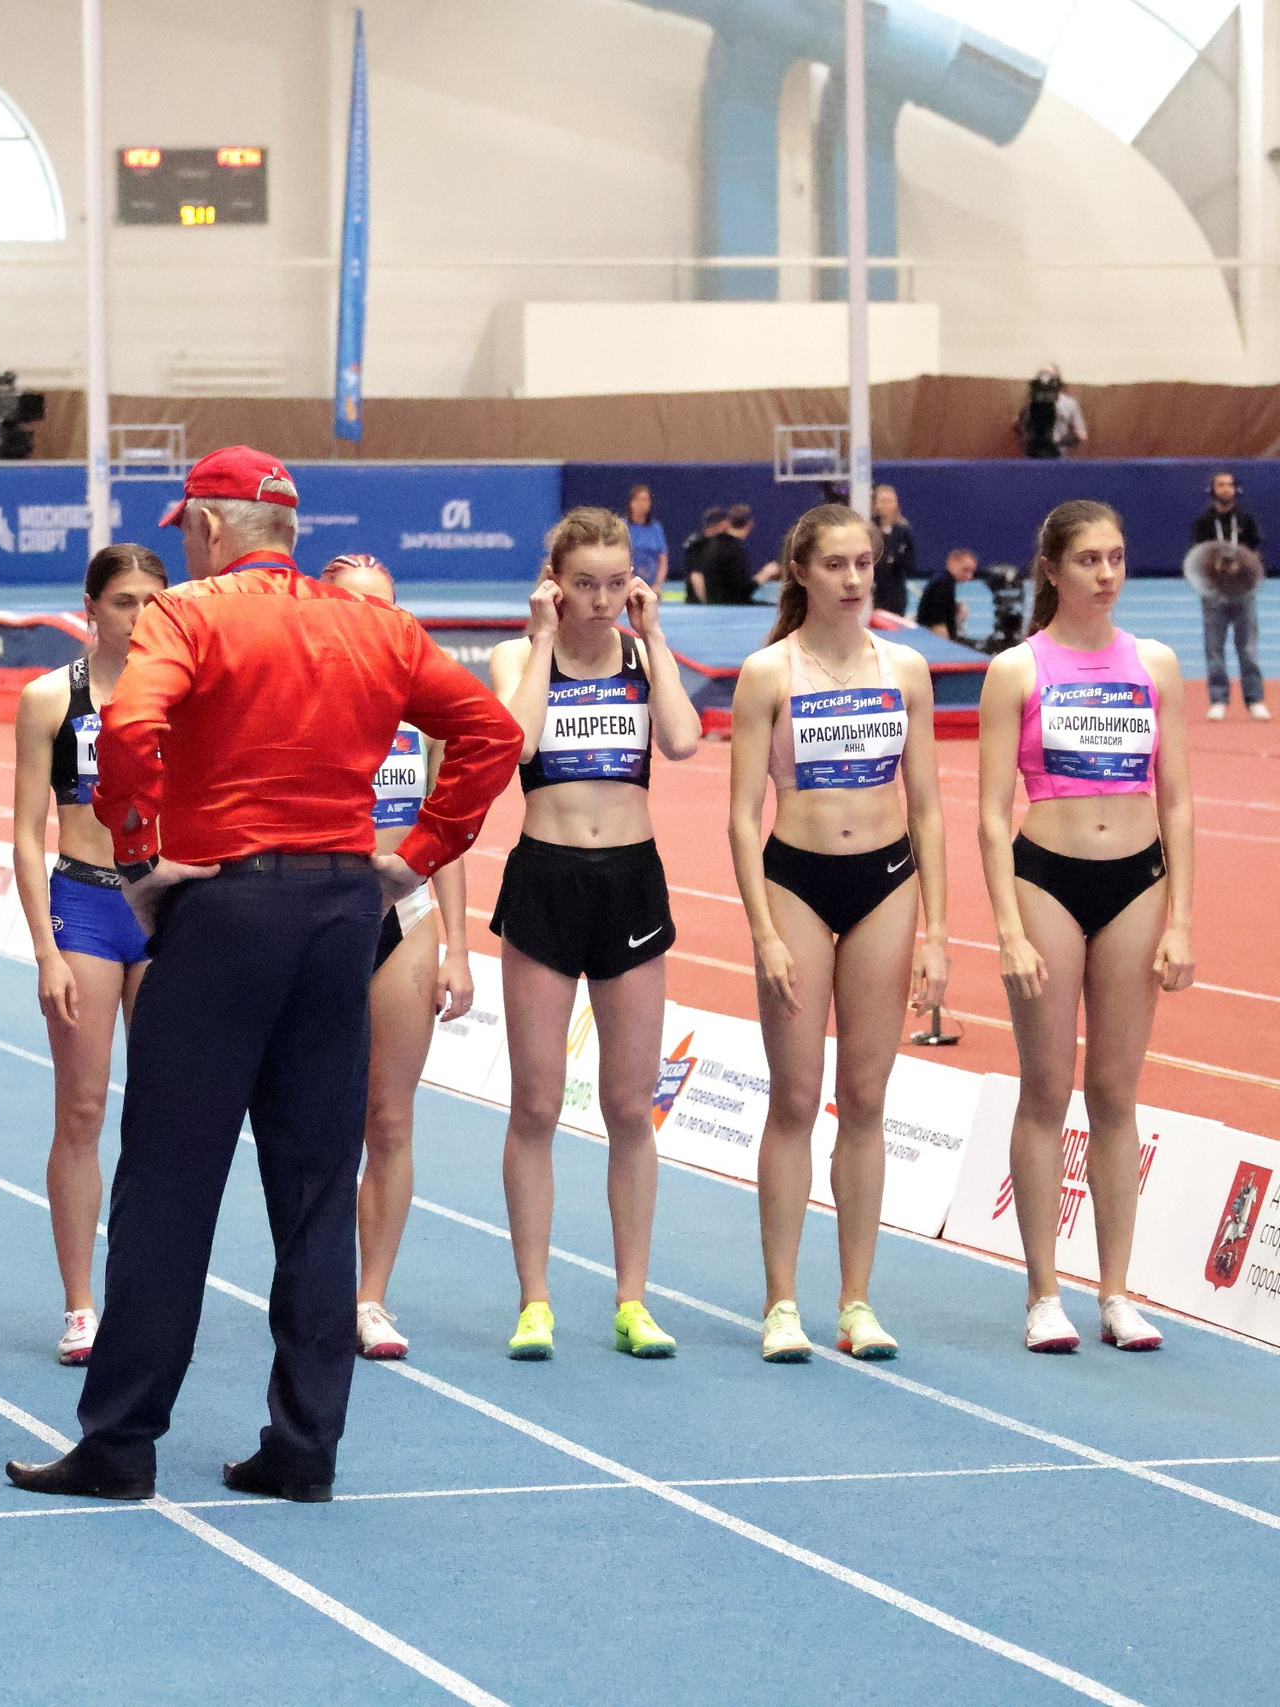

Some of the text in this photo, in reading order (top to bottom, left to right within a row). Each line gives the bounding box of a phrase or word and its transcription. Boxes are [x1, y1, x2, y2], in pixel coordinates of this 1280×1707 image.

[801, 695, 851, 714] Русская
[1051, 687, 1102, 703] Русская
[555, 716, 636, 738] АНДРЕЕВА
[800, 722, 903, 744] КРАСИЛЬНИКОВА
[1048, 716, 1151, 734] КРАСИЛЬНИКОВА
[844, 743, 865, 753] АННА
[1079, 735, 1123, 746] АНАСТАСИЯ
[686, 1087, 745, 1115] соревнования
[714, 1125, 753, 1148] атлетике
